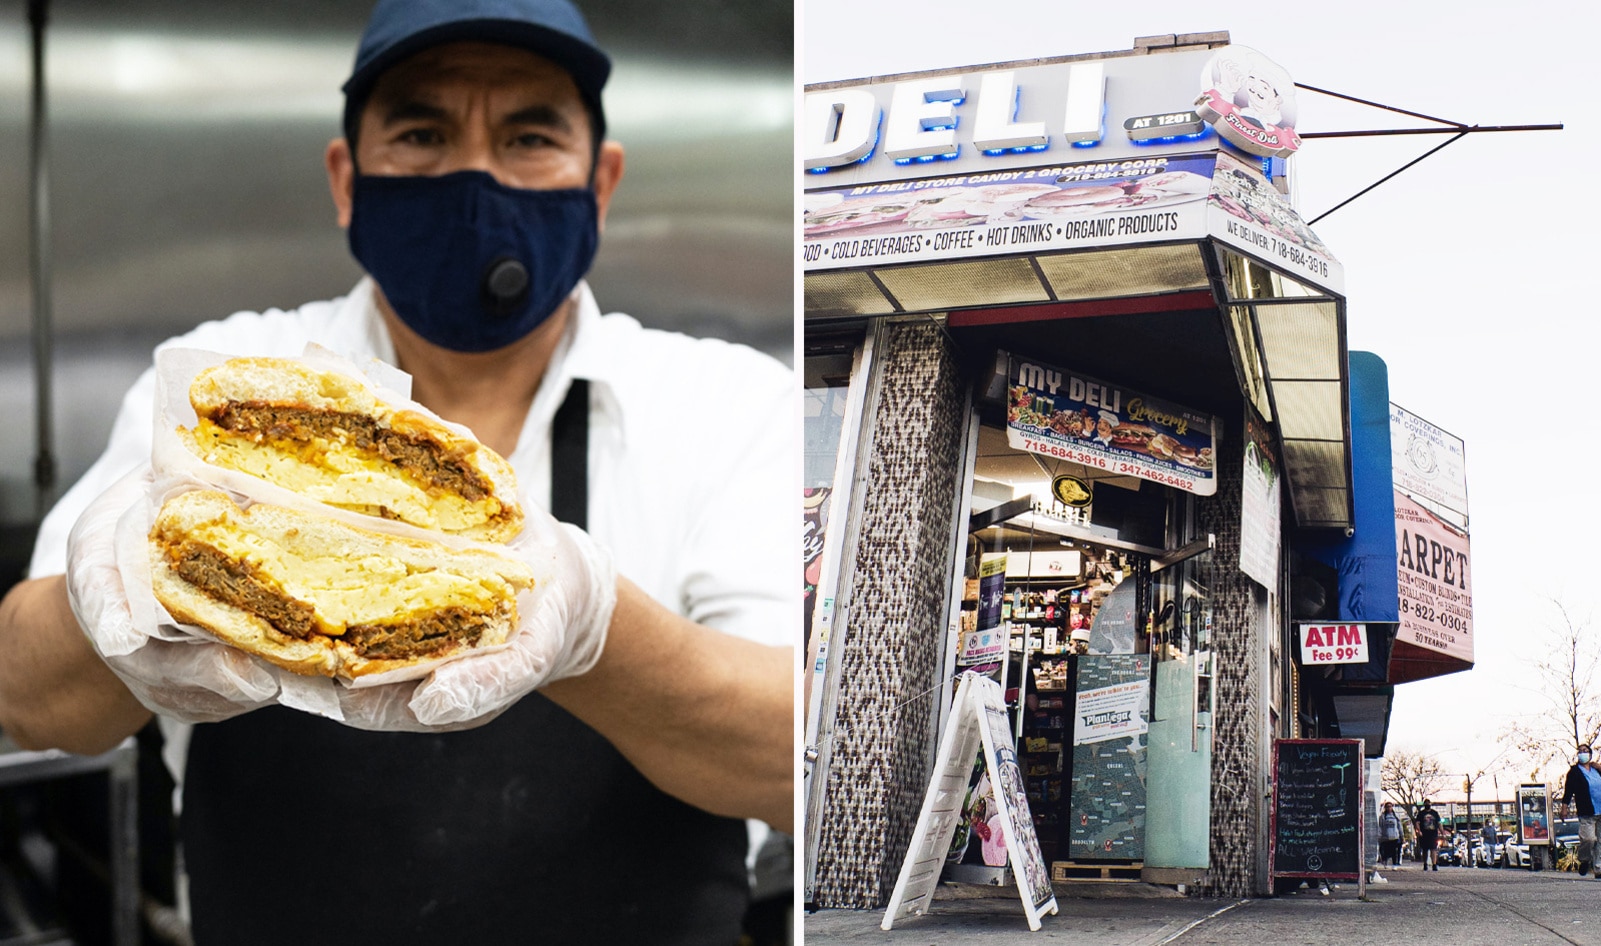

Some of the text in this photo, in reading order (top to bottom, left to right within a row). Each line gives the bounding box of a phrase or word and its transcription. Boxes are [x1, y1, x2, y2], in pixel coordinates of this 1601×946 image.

[804, 62, 1106, 165] DELI
[1133, 113, 1191, 129] AT 1201
[1225, 113, 1280, 144] Finest Deli
[850, 186, 877, 196] MY
[877, 182, 914, 193] DELI
[914, 176, 965, 190] STORE
[968, 171, 1023, 185] CANDY
[1038, 162, 1119, 178] GROCERY
[1121, 158, 1169, 170] CORP.
[831, 240, 859, 260] COLD
[860, 234, 923, 257] BEVERAGES
[934, 230, 975, 251] COFFEE
[987, 226, 1010, 246] HOT
[1011, 223, 1053, 244] DRINKS
[1065, 218, 1115, 240] ORGANIC
[1118, 212, 1178, 235] PRODUCTS
[1227, 219, 1238, 236] WE
[1271, 238, 1328, 278] 718-684-3916
[1018, 362, 1188, 436] MY DELI Grocery
[1010, 421, 1046, 435] BREAKFAST
[1050, 431, 1074, 442] BAGELS
[1109, 446, 1132, 457] SALADS
[1397, 410, 1442, 438] M. LOTZKAR
[1019, 431, 1041, 441] GYROS
[1045, 438, 1065, 448] HALAL
[1066, 443, 1083, 452] FOOD
[1087, 448, 1104, 457] COLD
[1104, 453, 1138, 465] BEVERAGES
[1024, 439, 1106, 468] 718-684-3916
[1120, 463, 1193, 490] 347-462-6482
[1396, 528, 1468, 590] ARPET
[1414, 576, 1437, 595] CUSTOM
[1438, 585, 1458, 602] BLINDS
[1460, 593, 1473, 608] TILE
[1305, 624, 1362, 648] ATM
[1415, 632, 1424, 644] 50
[1312, 649, 1333, 662] Fee
[1086, 711, 1129, 726] Plantega
